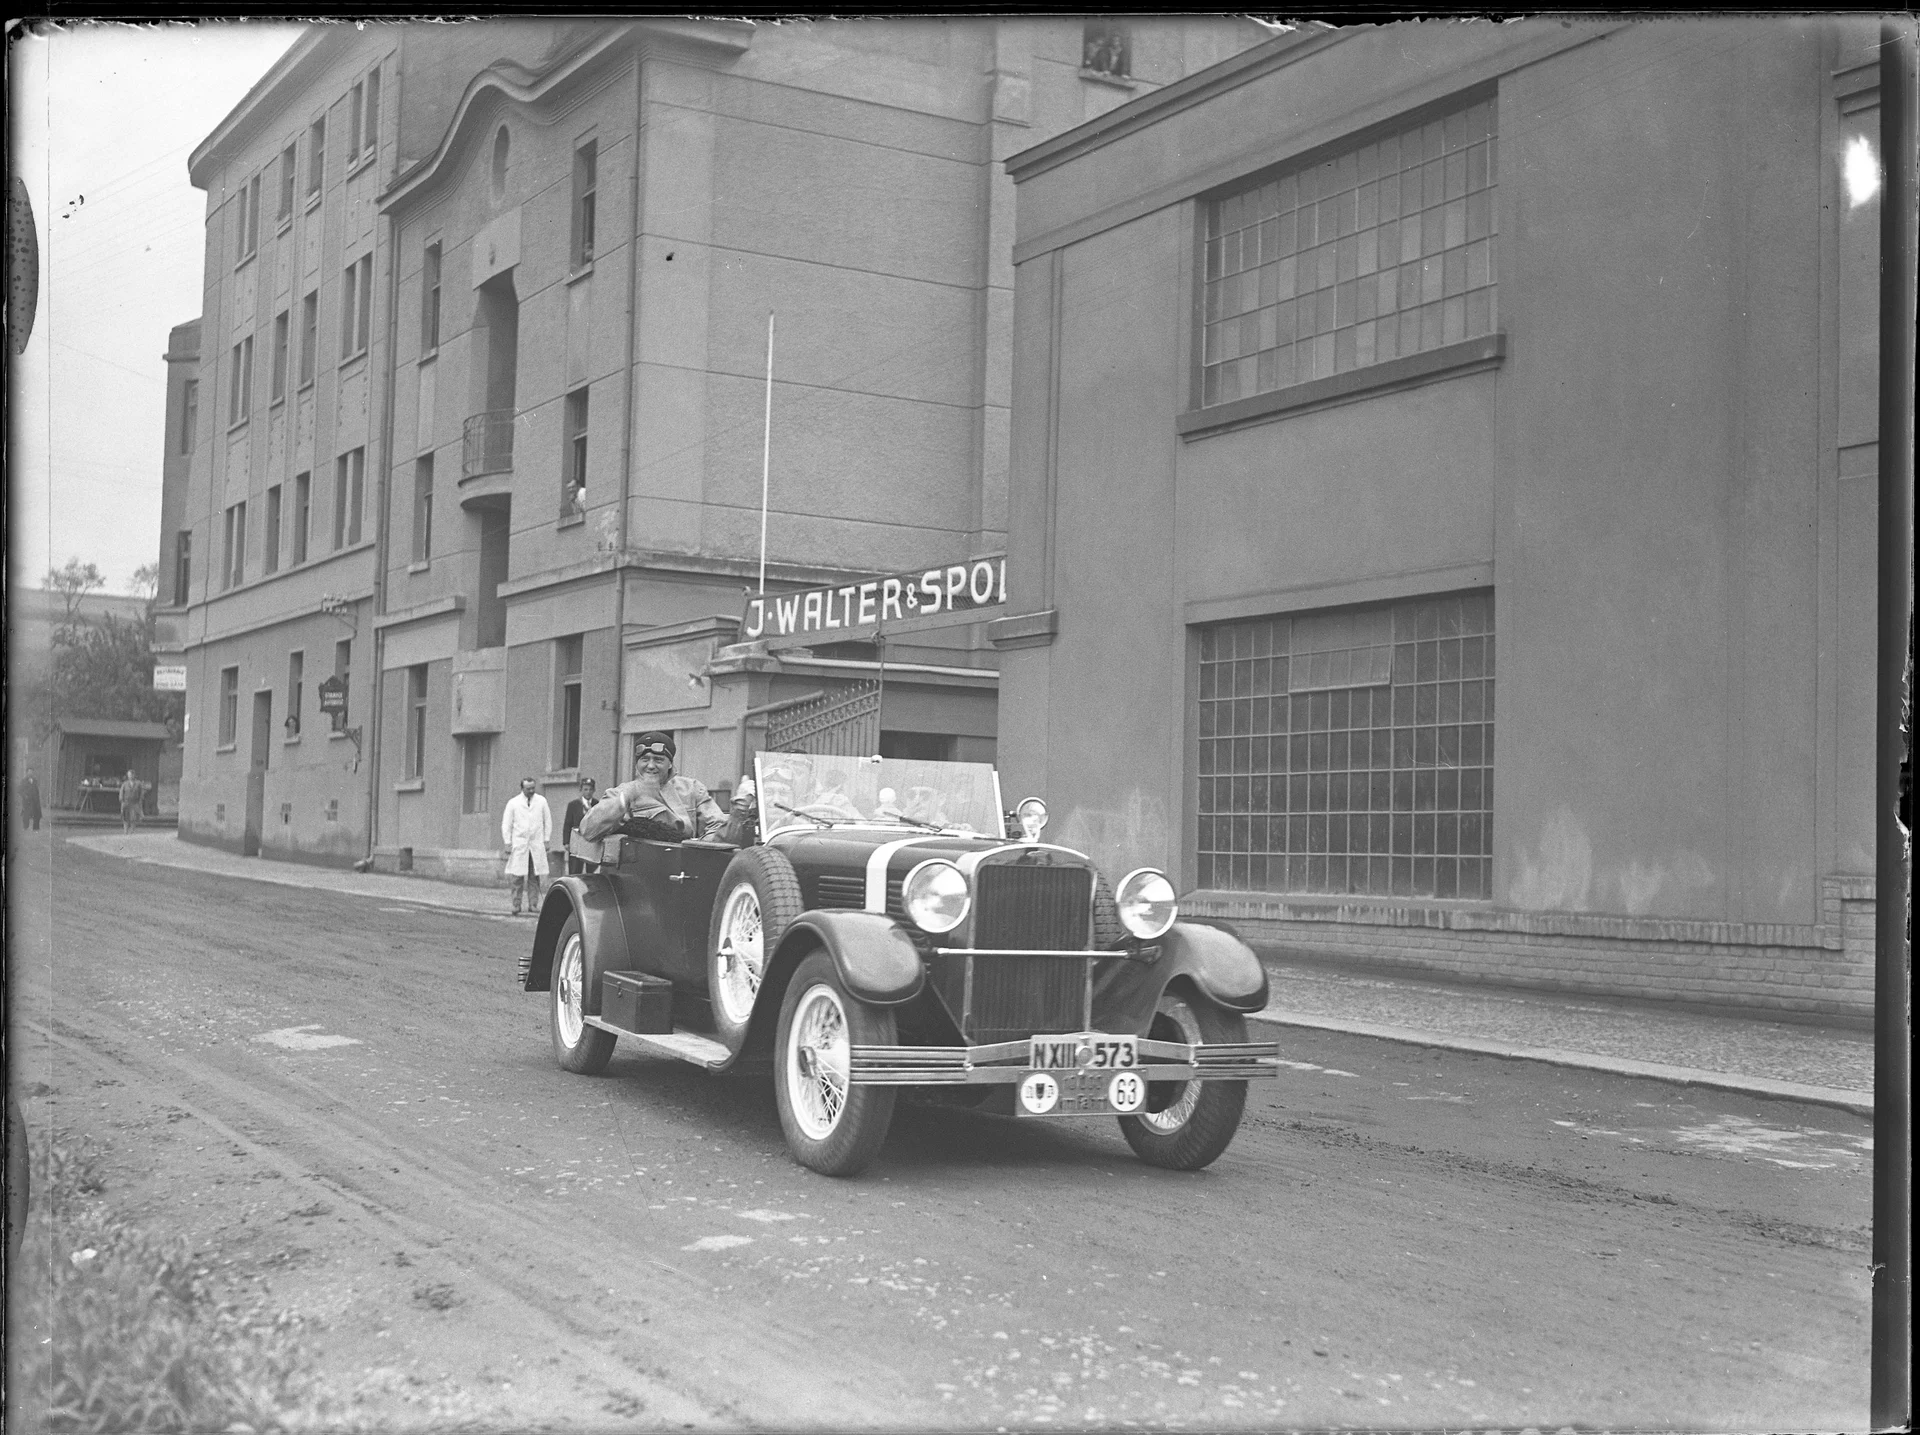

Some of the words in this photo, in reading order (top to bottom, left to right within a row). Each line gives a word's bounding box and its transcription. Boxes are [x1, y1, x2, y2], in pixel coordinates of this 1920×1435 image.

[906, 582, 919, 609] &
[1094, 1042, 1135, 1068] 573
[1116, 1078, 1137, 1105] 63
